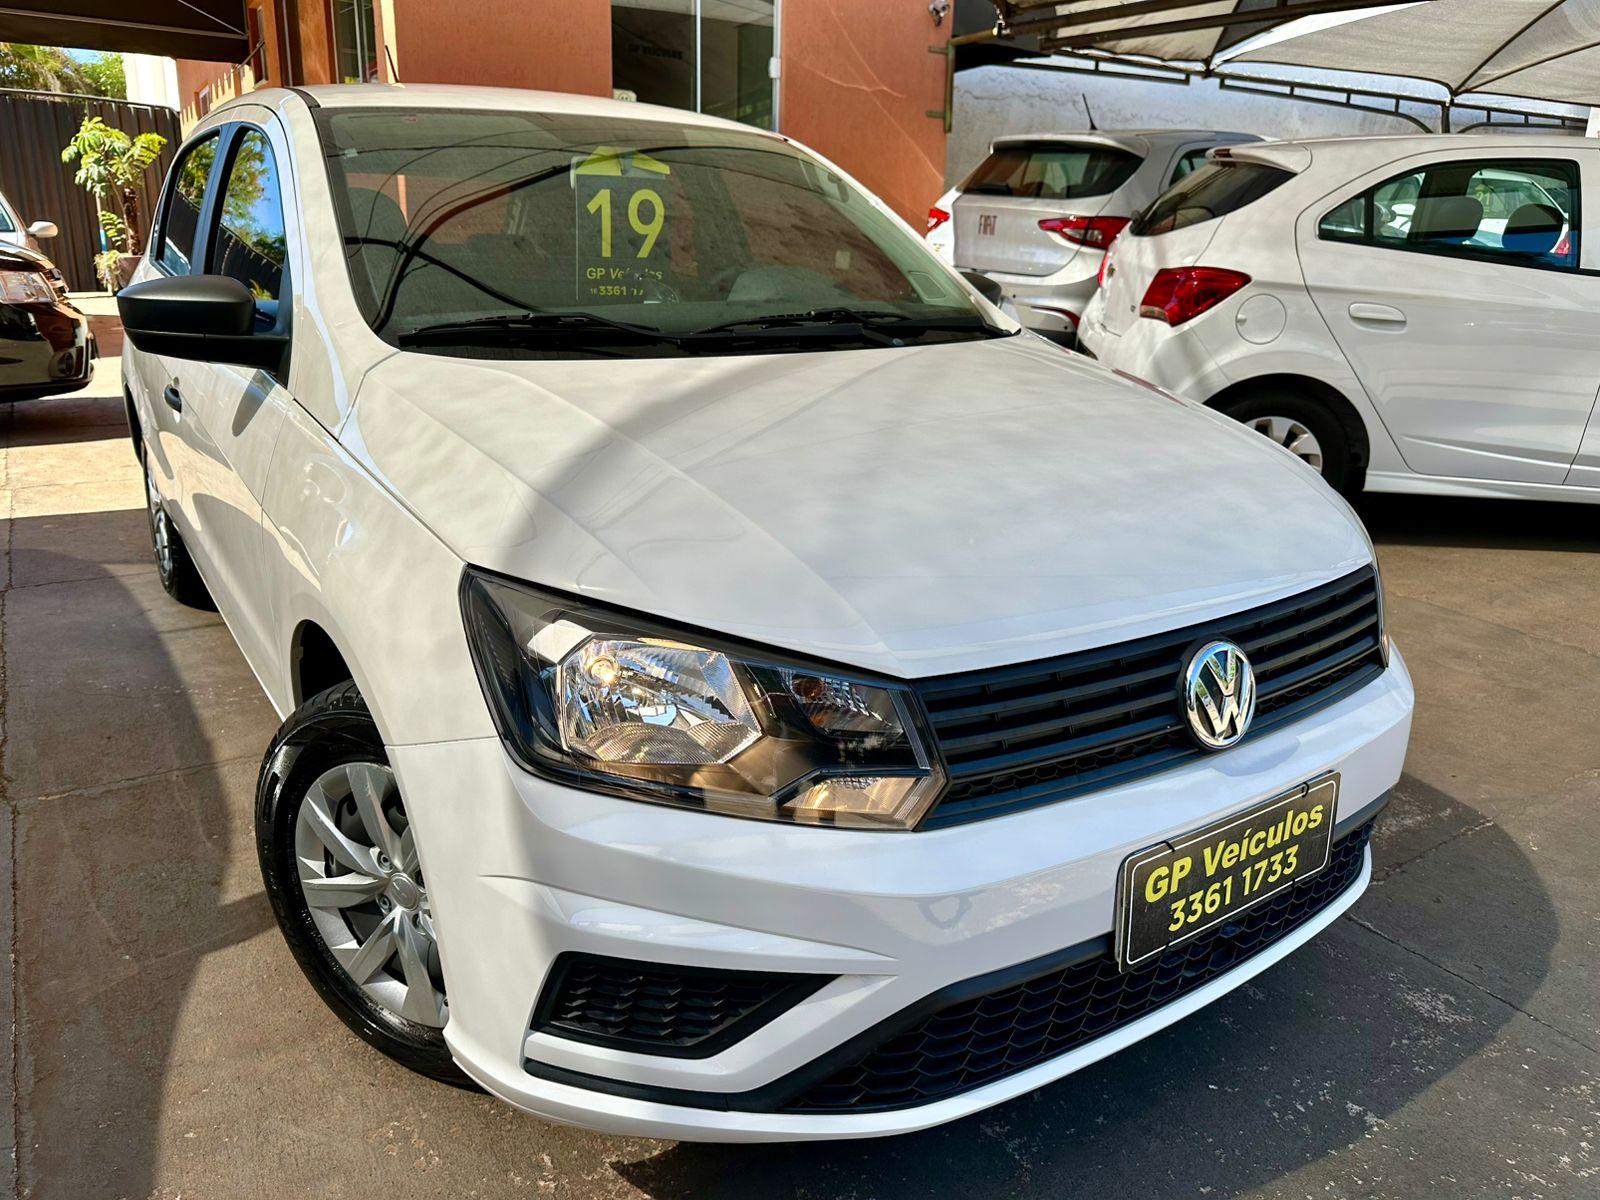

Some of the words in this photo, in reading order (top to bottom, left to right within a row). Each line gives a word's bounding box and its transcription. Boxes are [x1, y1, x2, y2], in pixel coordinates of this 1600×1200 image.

[587, 189, 665, 258] 19
[978, 214, 997, 235] FIAT
[586, 267, 606, 281] GP
[599, 285, 627, 296] 3361
[1144, 855, 1193, 904] GP
[1202, 803, 1324, 878] Veículos
[1168, 874, 1232, 933] 3361
[1241, 843, 1299, 897] 1733
